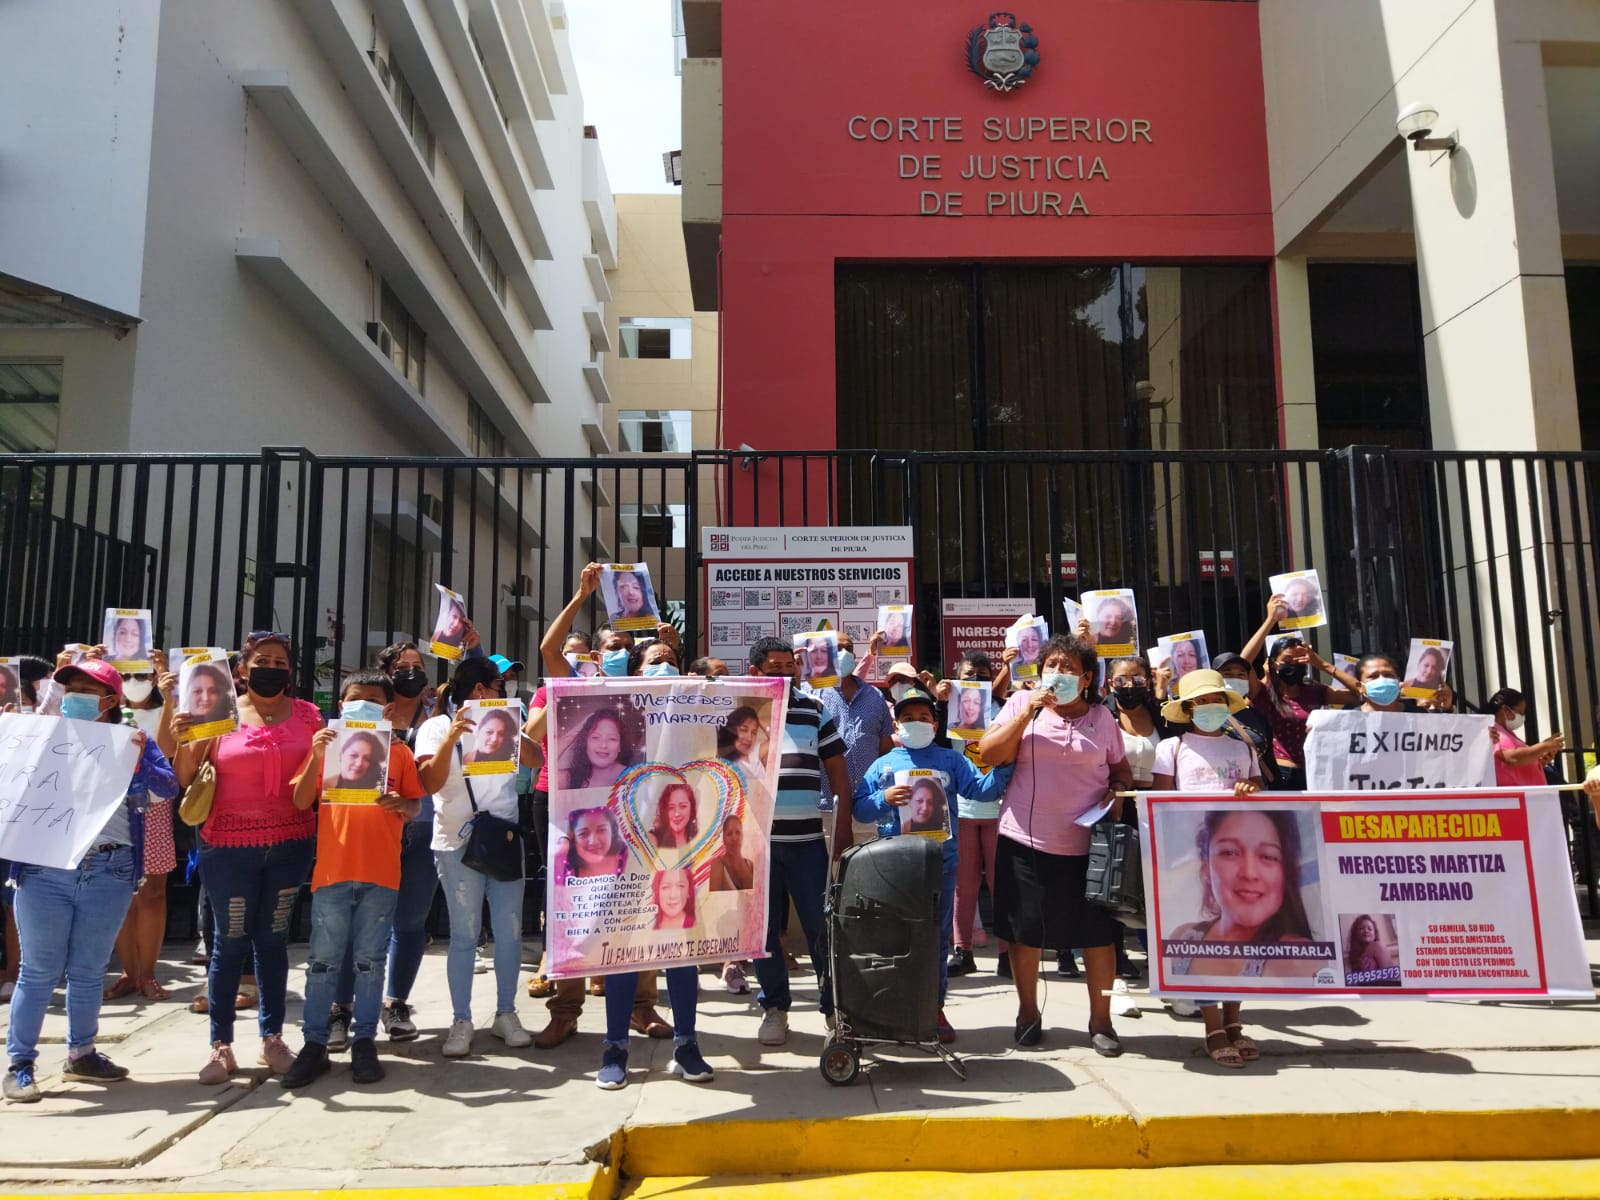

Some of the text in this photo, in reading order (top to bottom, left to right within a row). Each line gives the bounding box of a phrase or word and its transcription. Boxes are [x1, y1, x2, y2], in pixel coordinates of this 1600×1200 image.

[848, 115, 1153, 143] CORTE SUPERIOR
[898, 155, 1109, 180] DE JUSTICIA
[920, 191, 1089, 216] DE PIURA
[791, 535, 819, 543] CORTE
[872, 535, 906, 543] JUSTICIA
[831, 545, 867, 553] DE PIURA
[715, 567, 901, 582] ACCEDE A NUESTROS SERVICIOS
[952, 626, 1008, 637] INGRESO
[956, 640, 1006, 649] MAGISTRA
[632, 693, 733, 706] MERCEDES
[646, 711, 726, 725] MARITZA
[1349, 731, 1464, 754] EXIGIMOS
[1338, 813, 1503, 839] DESAPARECIDA
[1338, 853, 1506, 874] MERCEDES MARTIZA
[630, 872, 651, 882] DIOS
[590, 884, 610, 892] QUE
[1379, 881, 1474, 902] ZAMBRANO
[588, 890, 646, 901] ENCUENTRES
[593, 900, 632, 909] PROTEJA
[555, 912, 567, 920] TE
[572, 909, 614, 919] PERMITA
[603, 917, 622, 925] CON
[567, 928, 590, 936] BIEN
[1428, 924, 1438, 933] SU
[1468, 924, 1478, 932] SU
[1479, 923, 1495, 932] HIJO
[1420, 935, 1505, 944] Y TODAS SUS AMISTADES
[601, 941, 614, 966] TU
[615, 943, 645, 965] FAMILIA
[648, 944, 654, 961] Y
[656, 941, 683, 961] AMIGOS
[686, 941, 695, 957] TE
[1165, 942, 1333, 957] AYÚDANOS A ENCONTRARLA
[1416, 946, 1513, 955] ESTAMOS DESCONCERTADOS
[1416, 957, 1516, 967] CON TODO ESTO LES PEDIMOS
[1403, 969, 1422, 978] TODO
[1423, 969, 1433, 978] SU
[1434, 969, 1457, 978] APOYO
[1458, 969, 1477, 978] PARA
